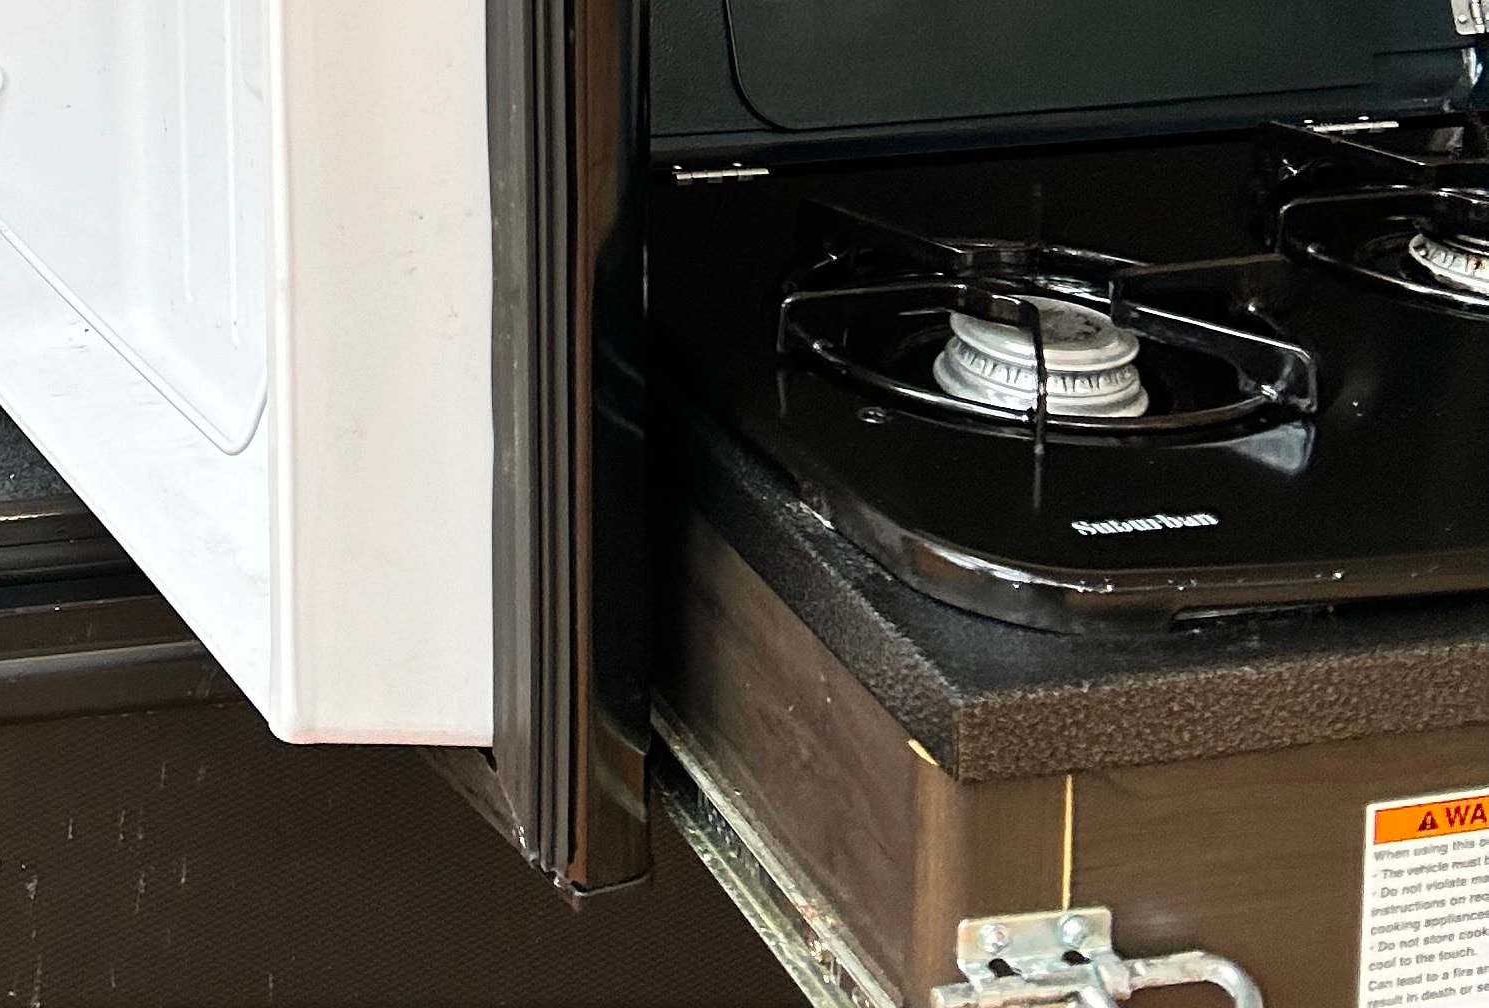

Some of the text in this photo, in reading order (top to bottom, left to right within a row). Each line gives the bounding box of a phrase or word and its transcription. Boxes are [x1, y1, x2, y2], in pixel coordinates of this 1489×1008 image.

[1071, 513, 1219, 535] Suburban
[1374, 849, 1410, 861] When
[1413, 844, 1449, 856] using
[1452, 839, 1476, 851] this
[1370, 920, 1421, 936] cooking
